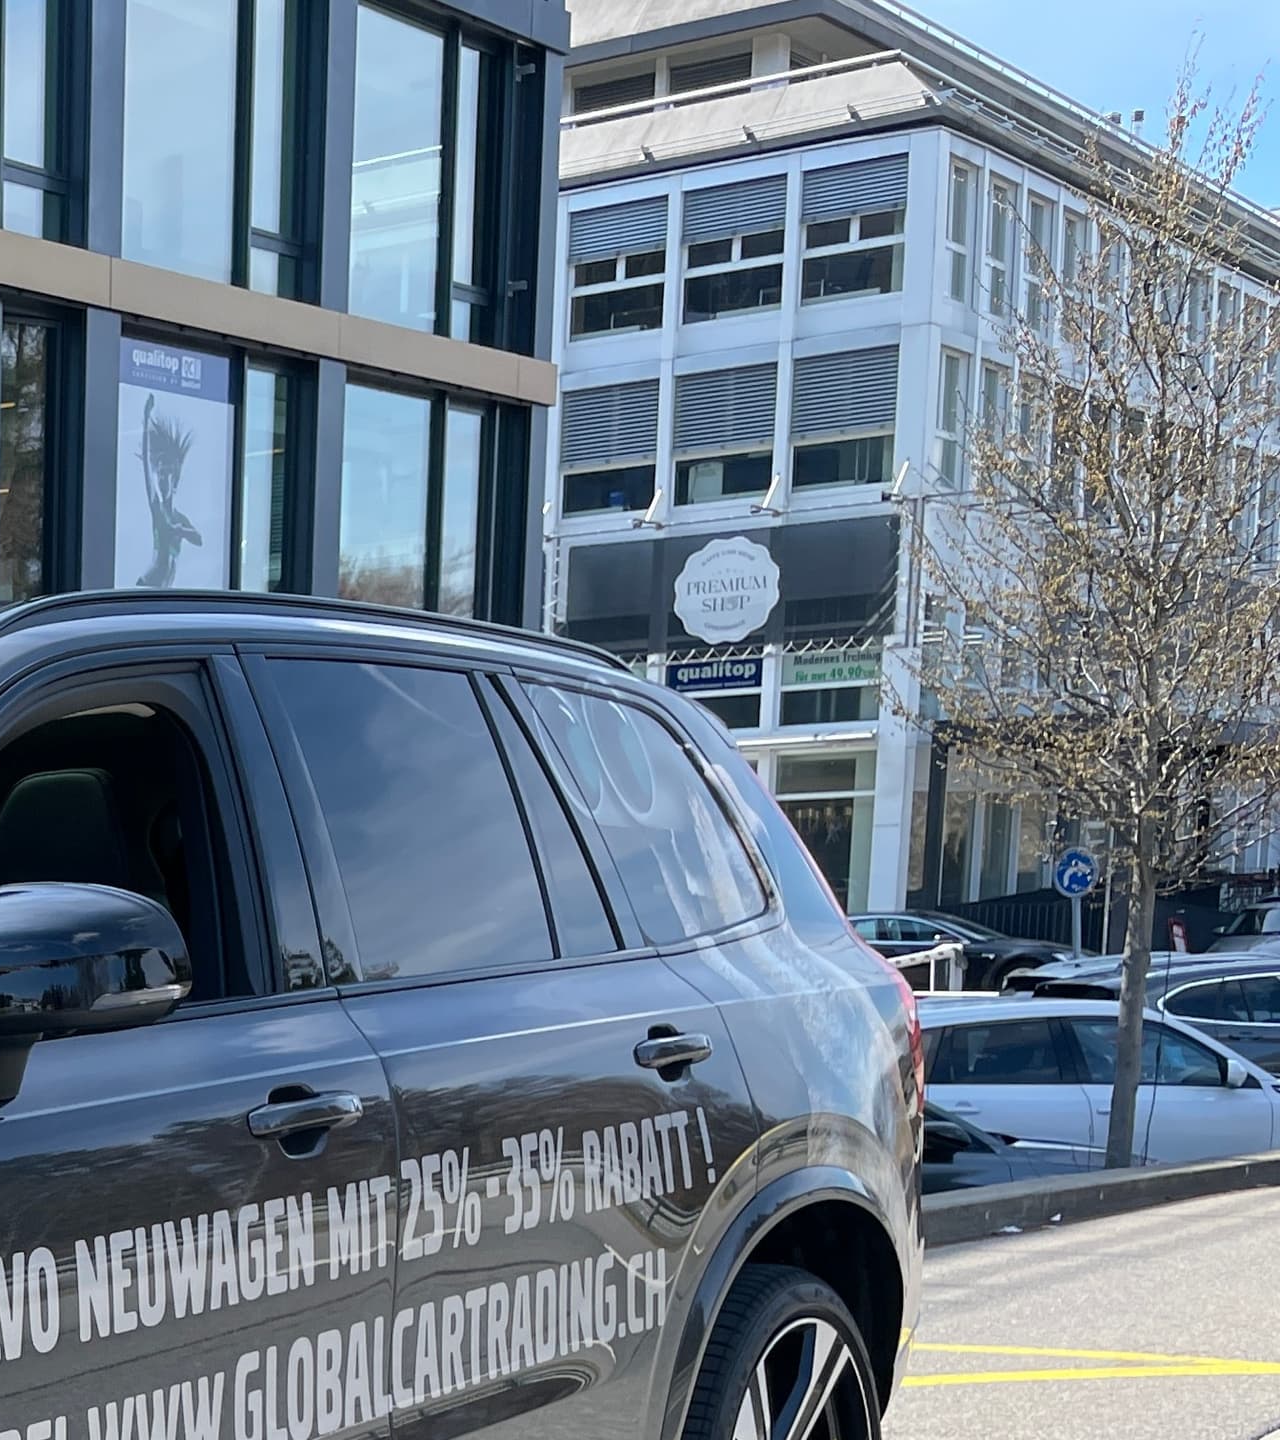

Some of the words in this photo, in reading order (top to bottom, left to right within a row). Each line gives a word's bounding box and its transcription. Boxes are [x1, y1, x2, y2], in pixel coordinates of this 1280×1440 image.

[132, 349, 180, 374] qualitop
[687, 575, 767, 596] PREMIUM
[701, 595, 751, 613] SHOP
[676, 661, 757, 683] qualitop
[74, 1190, 315, 1343] NEUWAGEN
[327, 1174, 391, 1281] MIT
[581, 1109, 693, 1214] RABATT
